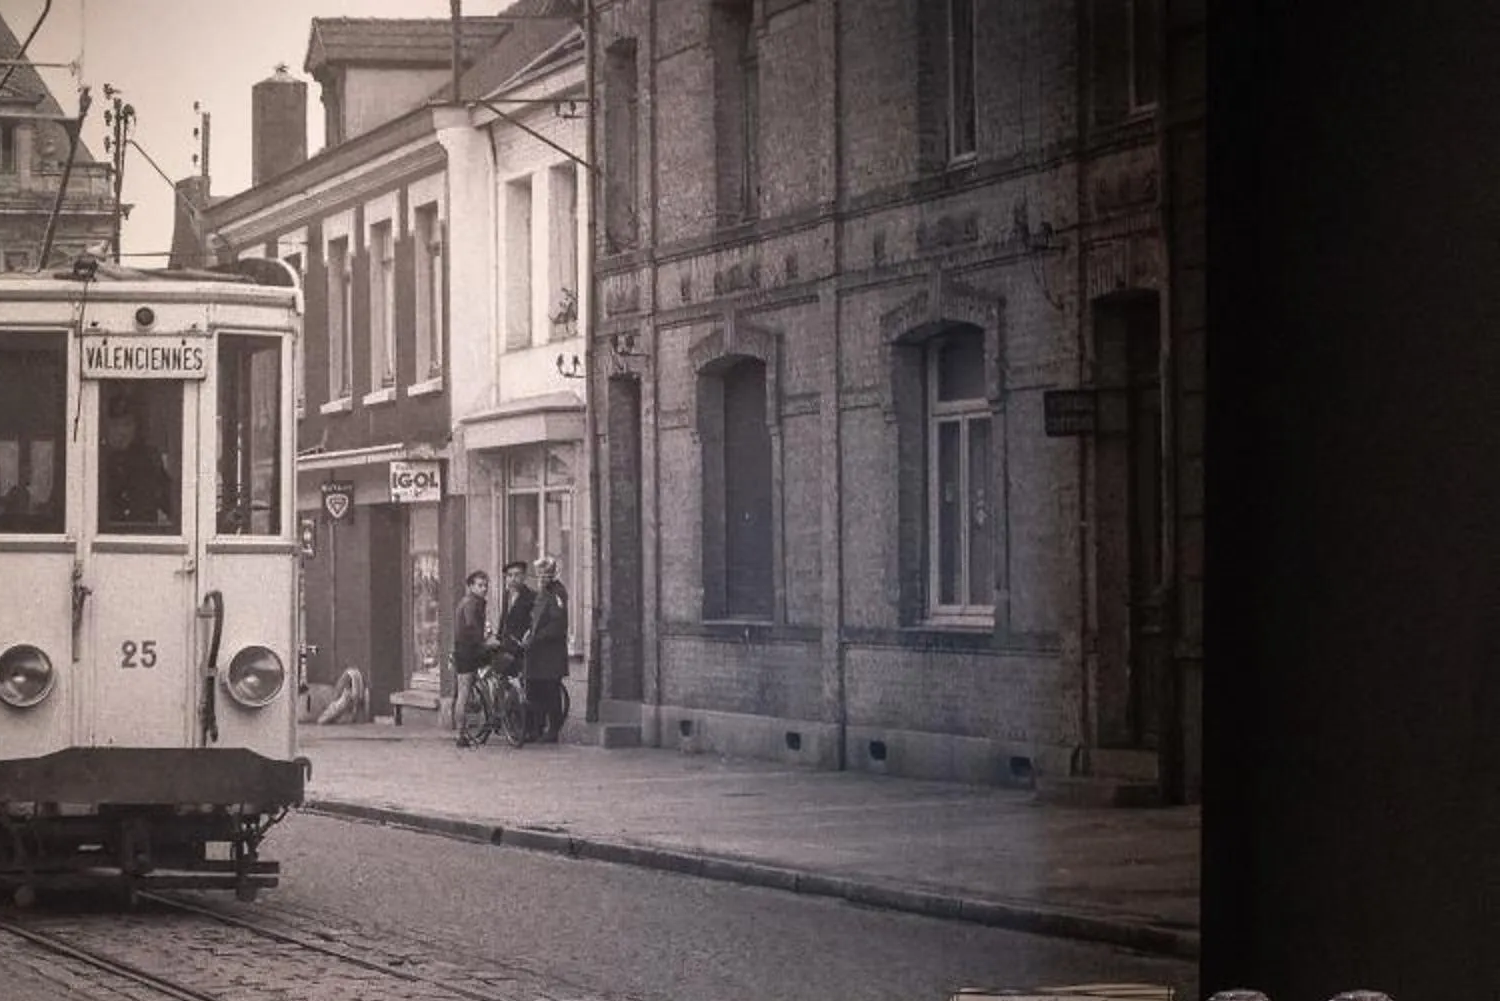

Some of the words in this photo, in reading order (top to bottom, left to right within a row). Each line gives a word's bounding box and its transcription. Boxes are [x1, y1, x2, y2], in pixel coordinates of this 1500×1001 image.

[85, 346, 203, 371] VALENCIENNES
[392, 471, 438, 489] IGOL
[121, 640, 157, 669] 25
